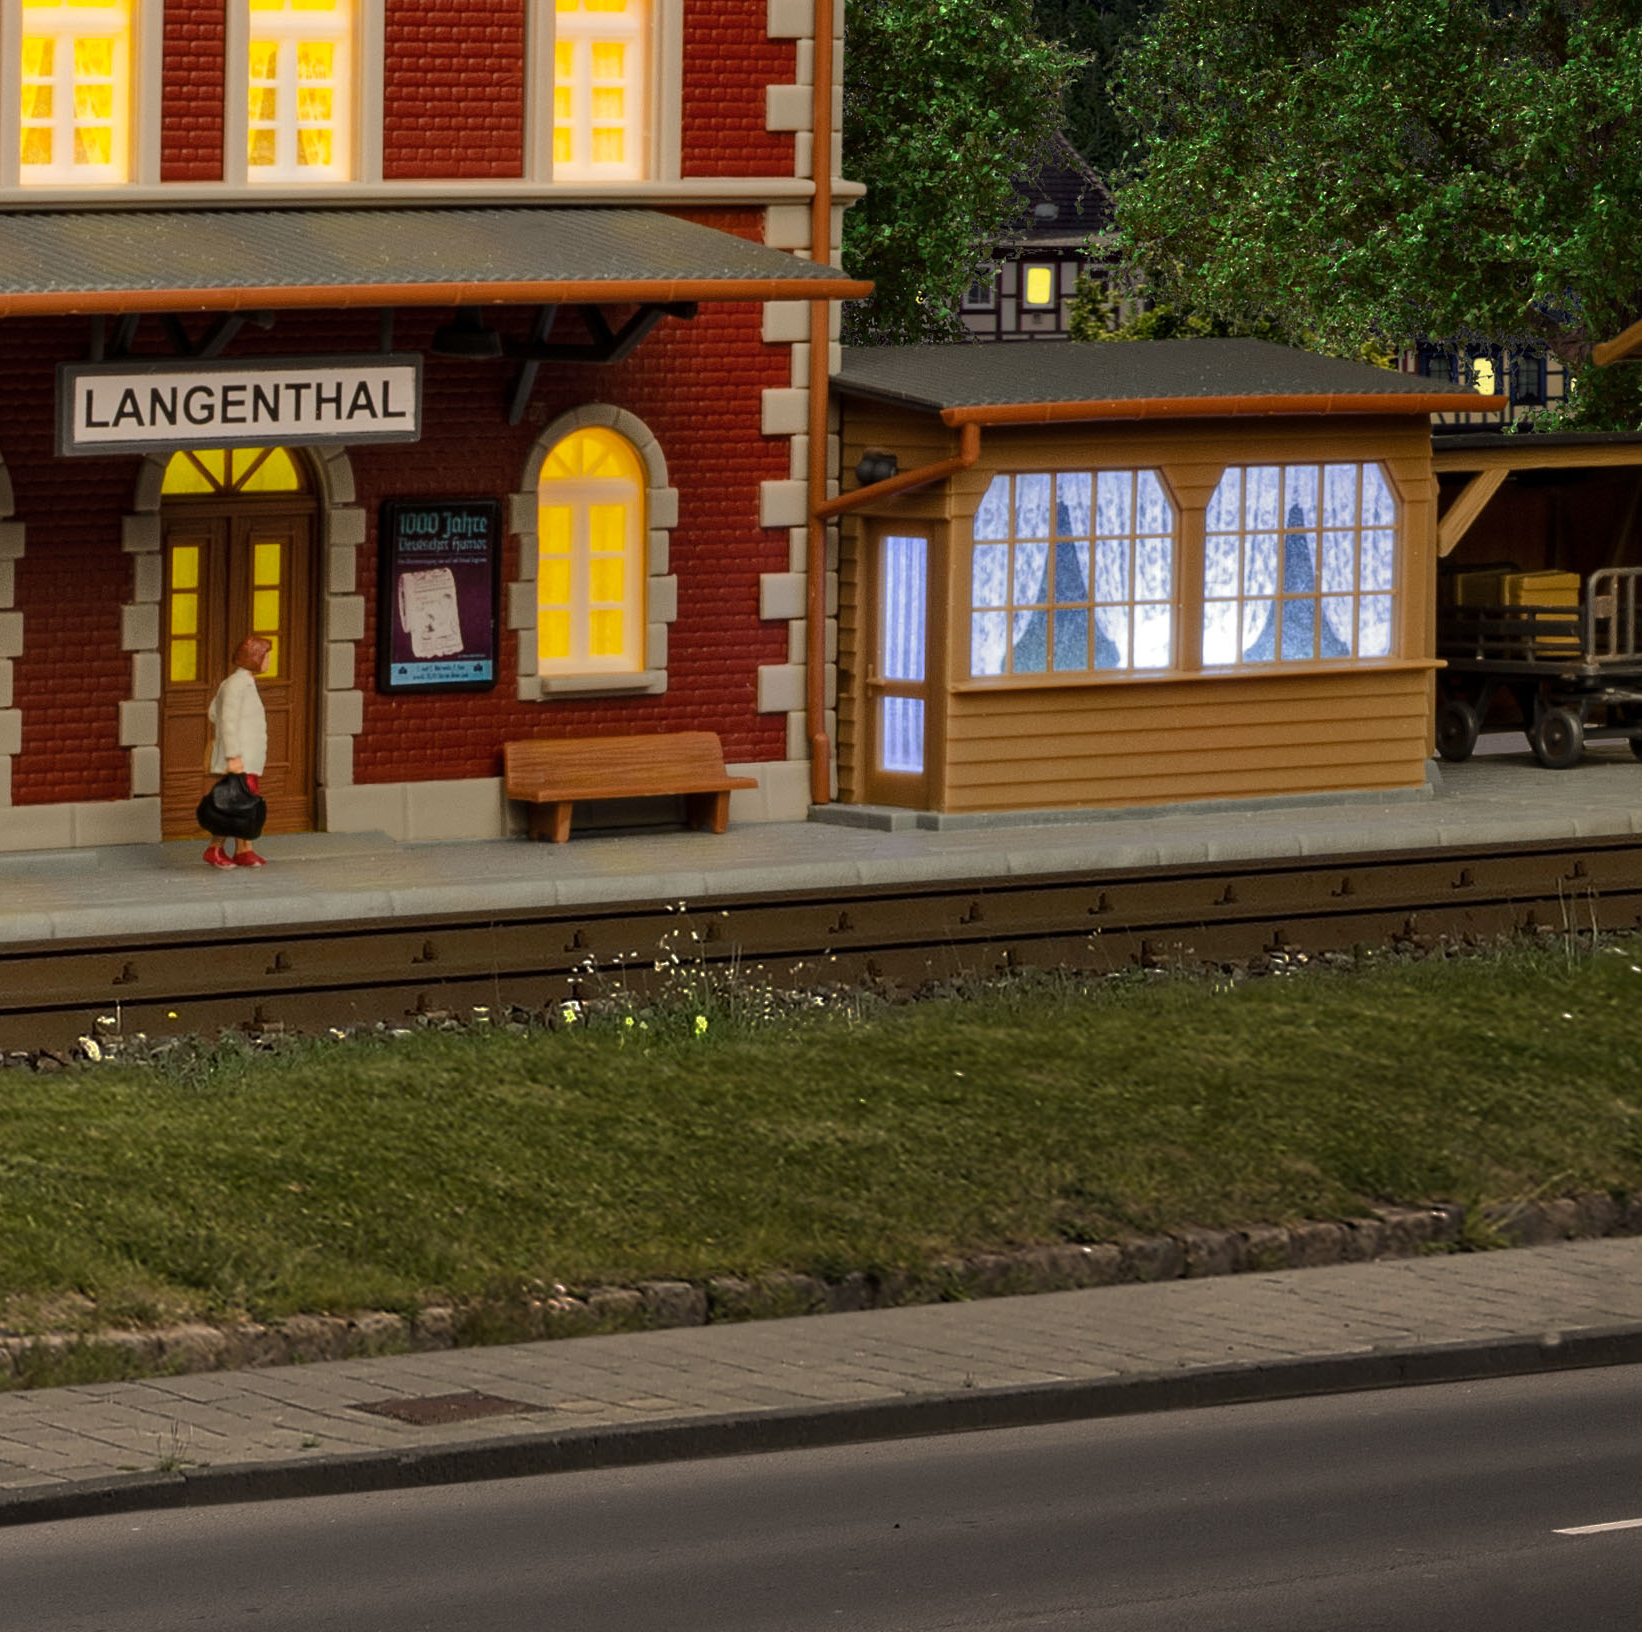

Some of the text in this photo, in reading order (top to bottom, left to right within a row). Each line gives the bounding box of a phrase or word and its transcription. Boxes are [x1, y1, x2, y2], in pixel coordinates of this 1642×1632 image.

[85, 380, 407, 428] LANGENTHAL
[400, 511, 488, 539] 1000 Jahre
